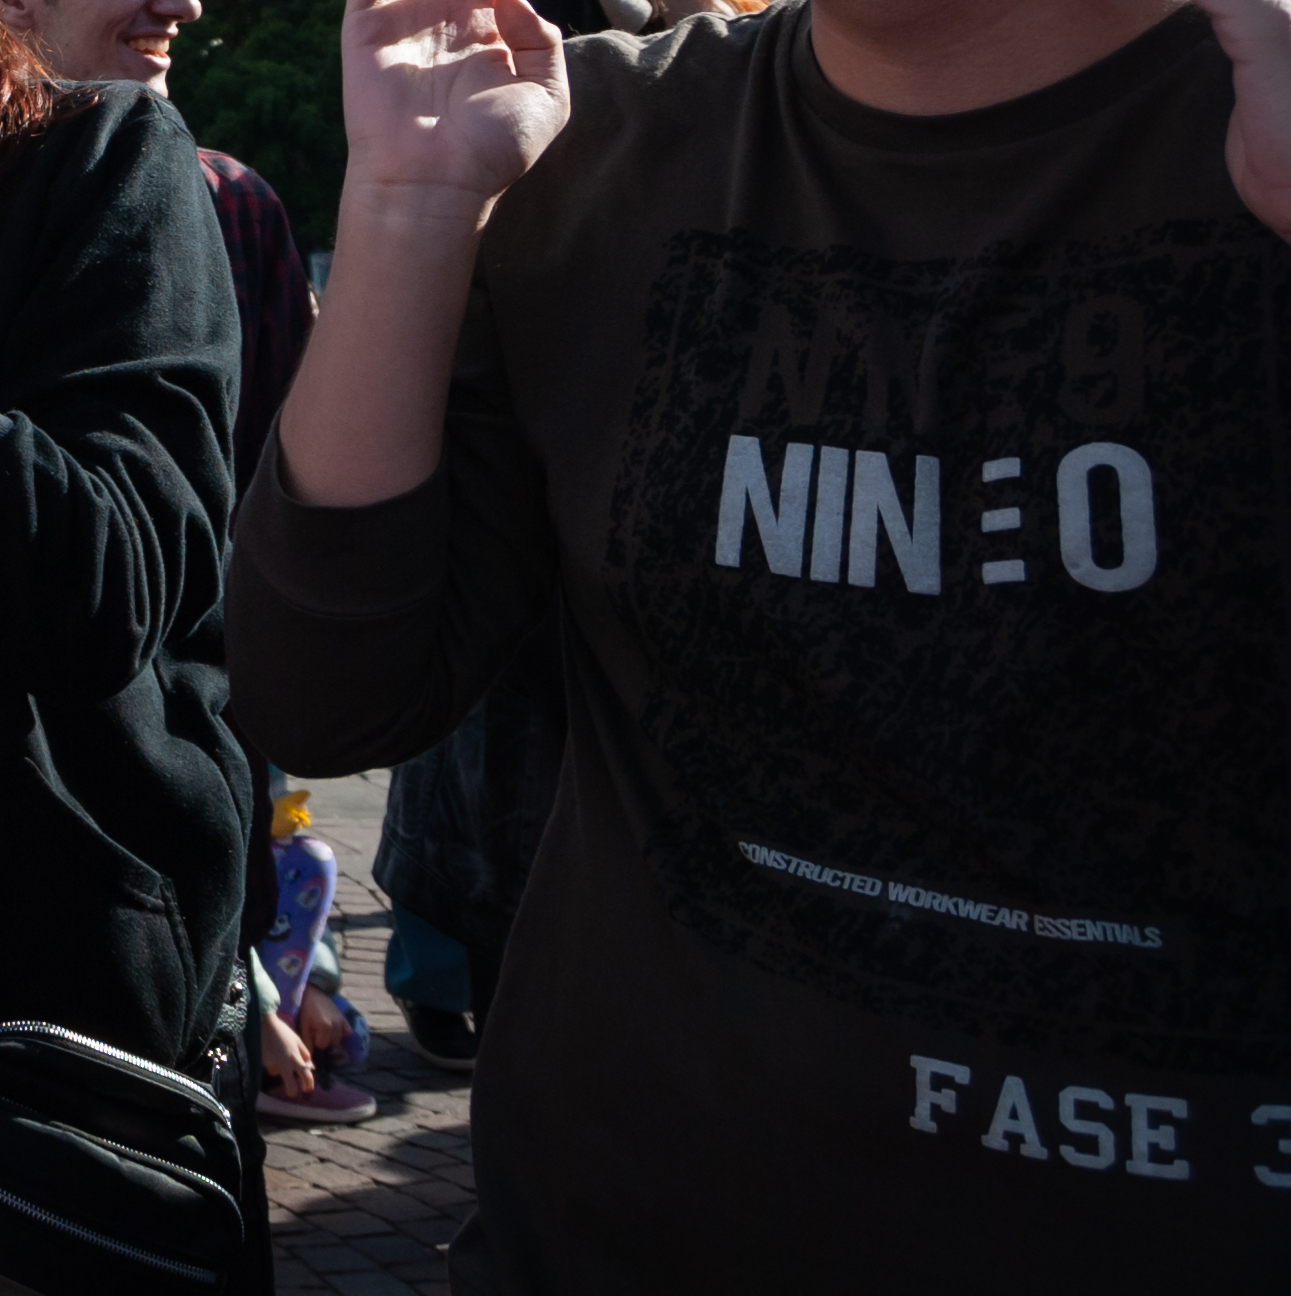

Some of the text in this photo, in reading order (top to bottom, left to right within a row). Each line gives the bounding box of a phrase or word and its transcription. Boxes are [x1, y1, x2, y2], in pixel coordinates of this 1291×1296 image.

[888, 880, 1029, 933] WORKWEAR
[1034, 913, 1164, 949] ESSENTIALS
[909, 1055, 1190, 1181] FASE
